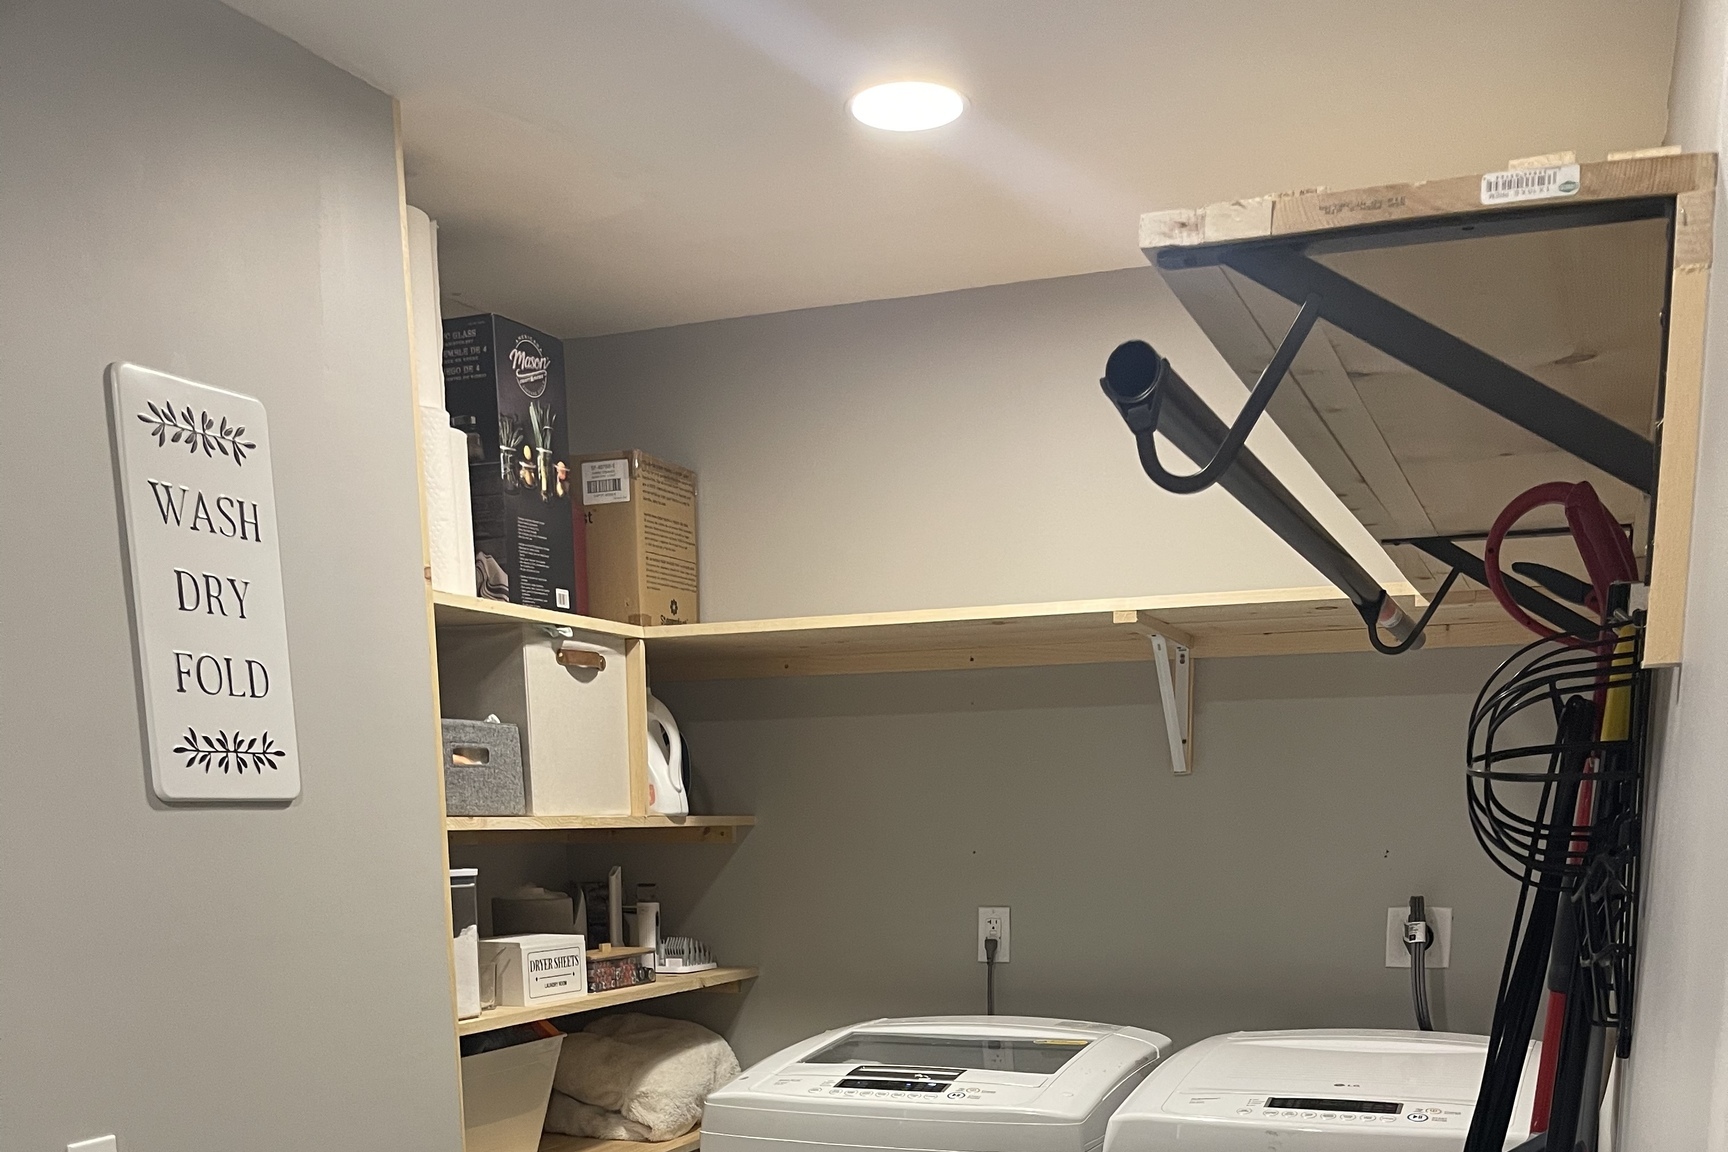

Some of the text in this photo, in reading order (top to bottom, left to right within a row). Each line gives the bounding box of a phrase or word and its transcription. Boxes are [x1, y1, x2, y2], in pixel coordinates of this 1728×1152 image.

[452, 329, 477, 340] GLASS
[509, 349, 551, 370] Mason
[147, 478, 262, 543] WASH
[173, 568, 251, 619] DRY
[172, 650, 270, 699] FOLD
[530, 955, 579, 972] DRYER SHEETS
